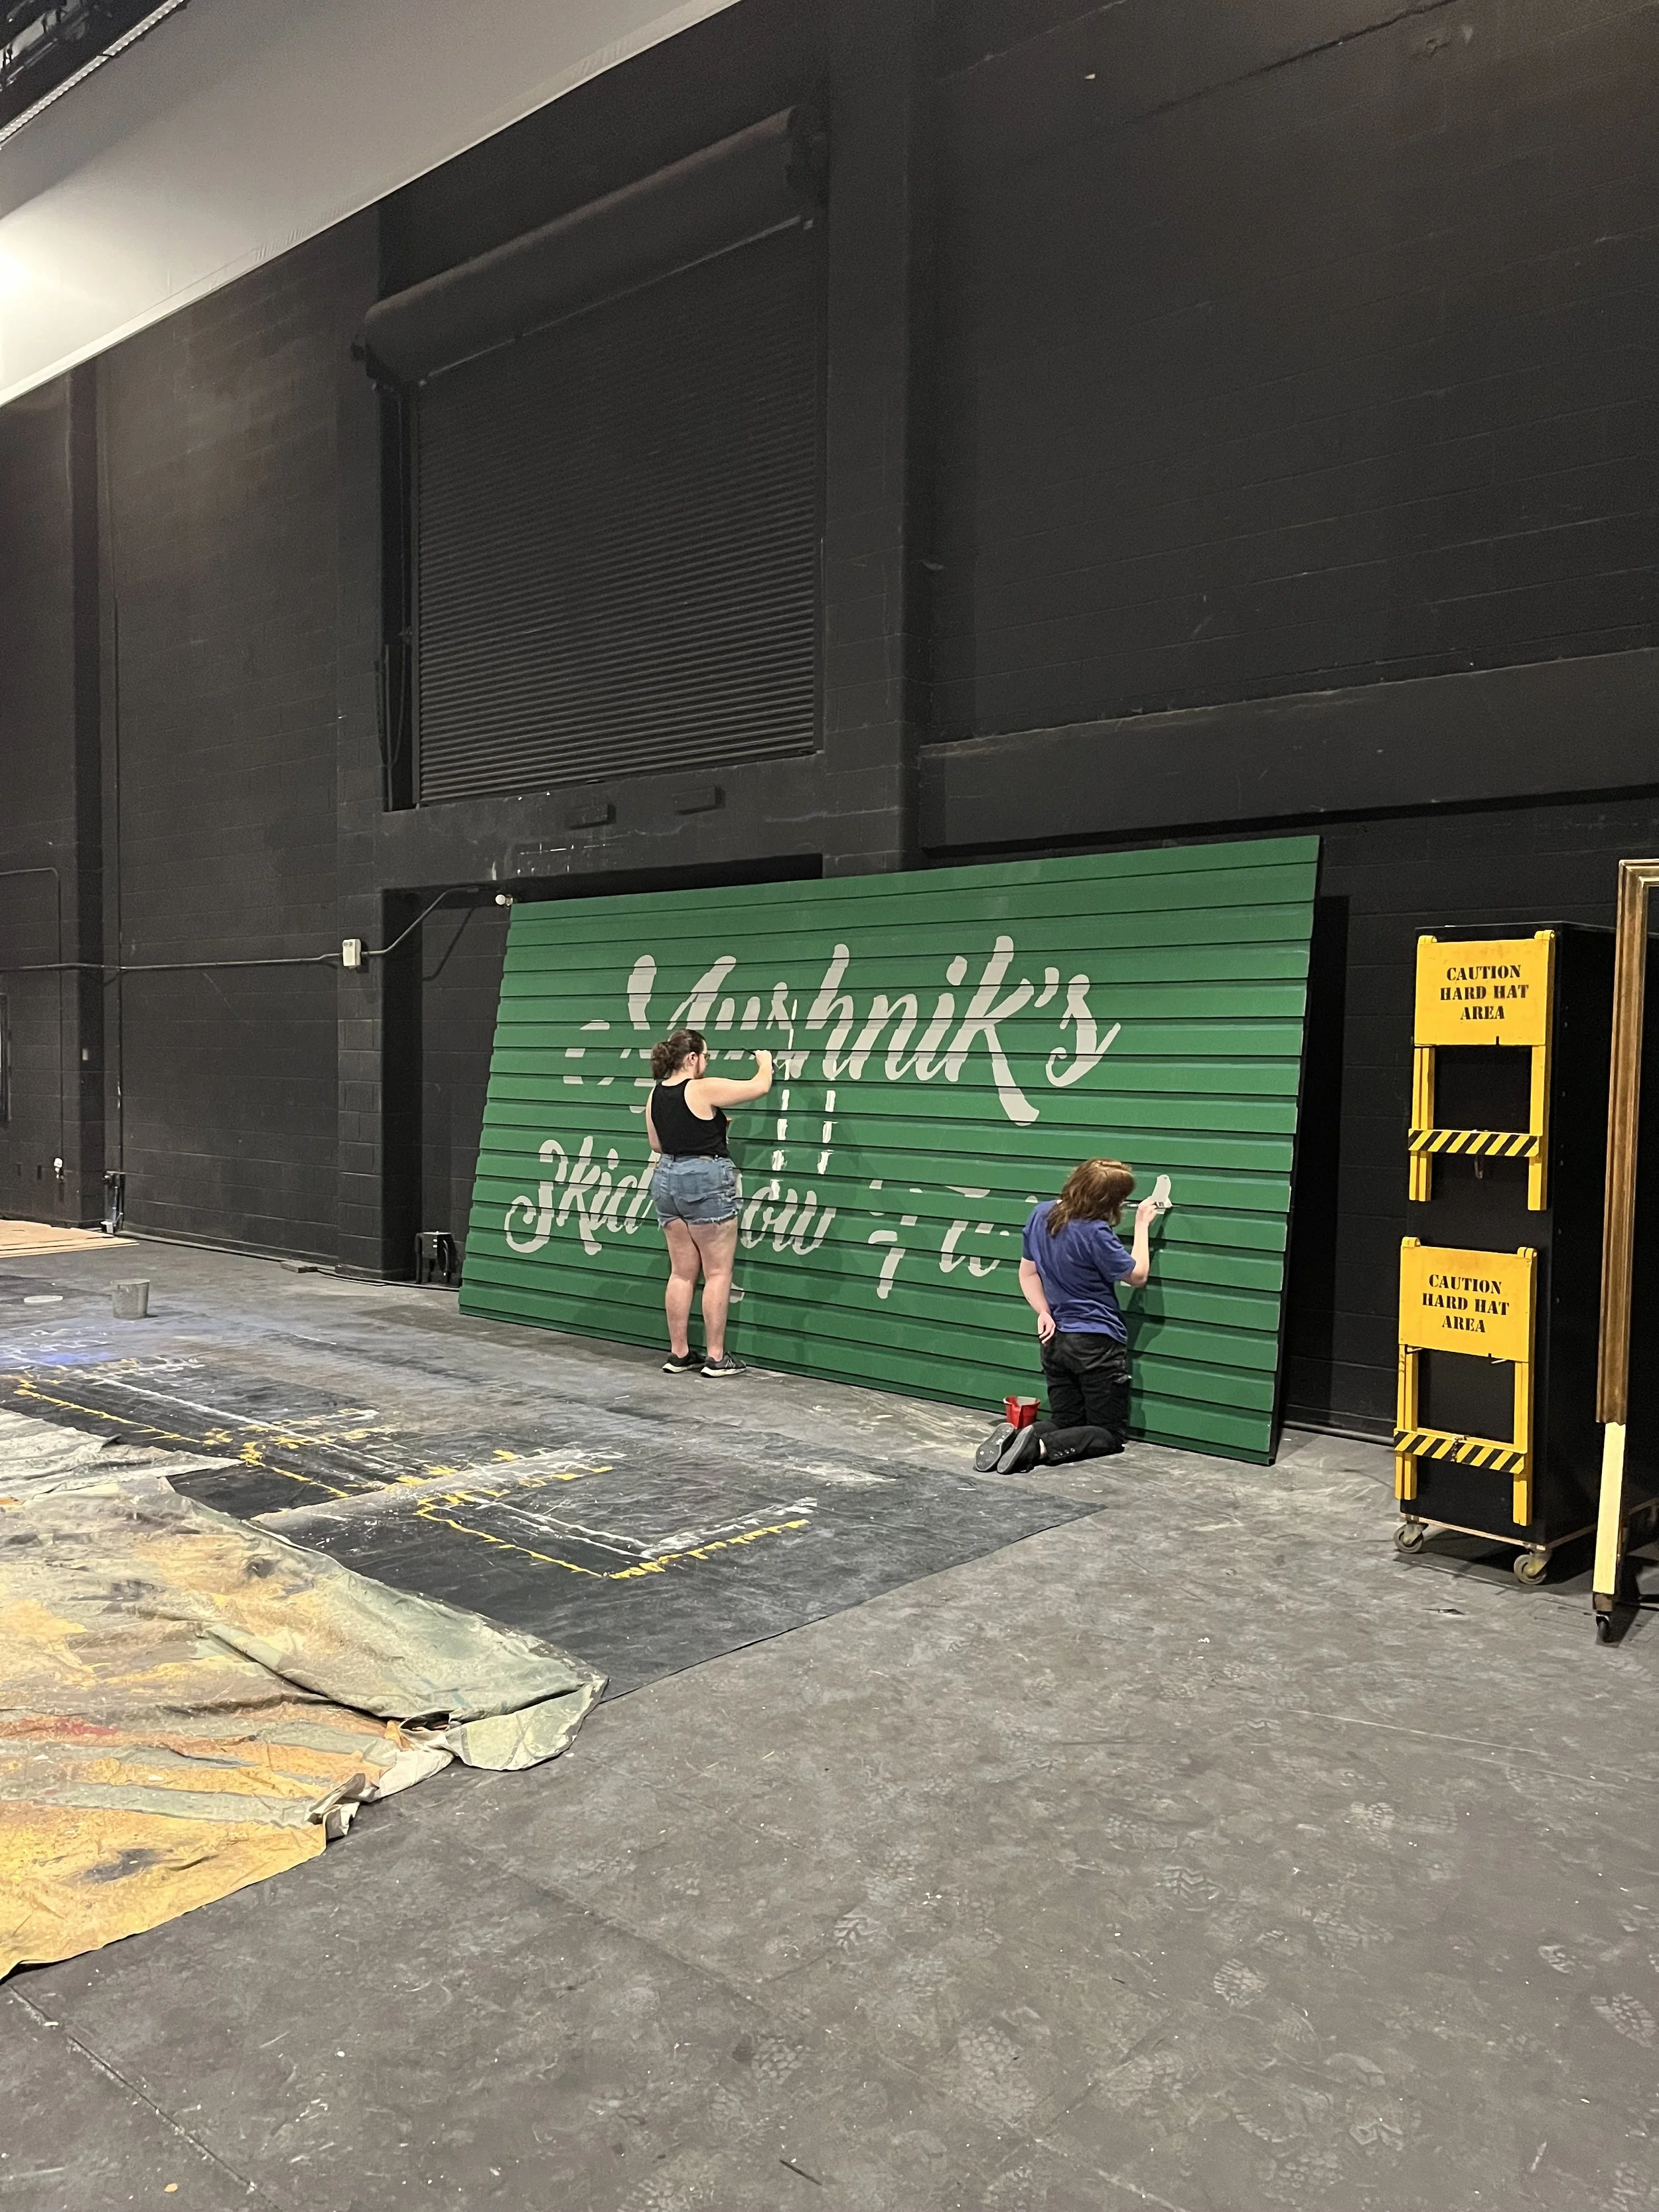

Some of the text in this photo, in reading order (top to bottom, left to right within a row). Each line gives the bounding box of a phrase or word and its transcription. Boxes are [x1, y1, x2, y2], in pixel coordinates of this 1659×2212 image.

[1446, 964, 1521, 982] CAUTION
[1440, 984, 1530, 1001] HARD HAT
[1460, 1005, 1505, 1021] AREA
[1428, 1273, 1502, 1295] CAUTION
[1422, 1291, 1510, 1317] HARD HAT
[1441, 1315, 1486, 1333] AREA
